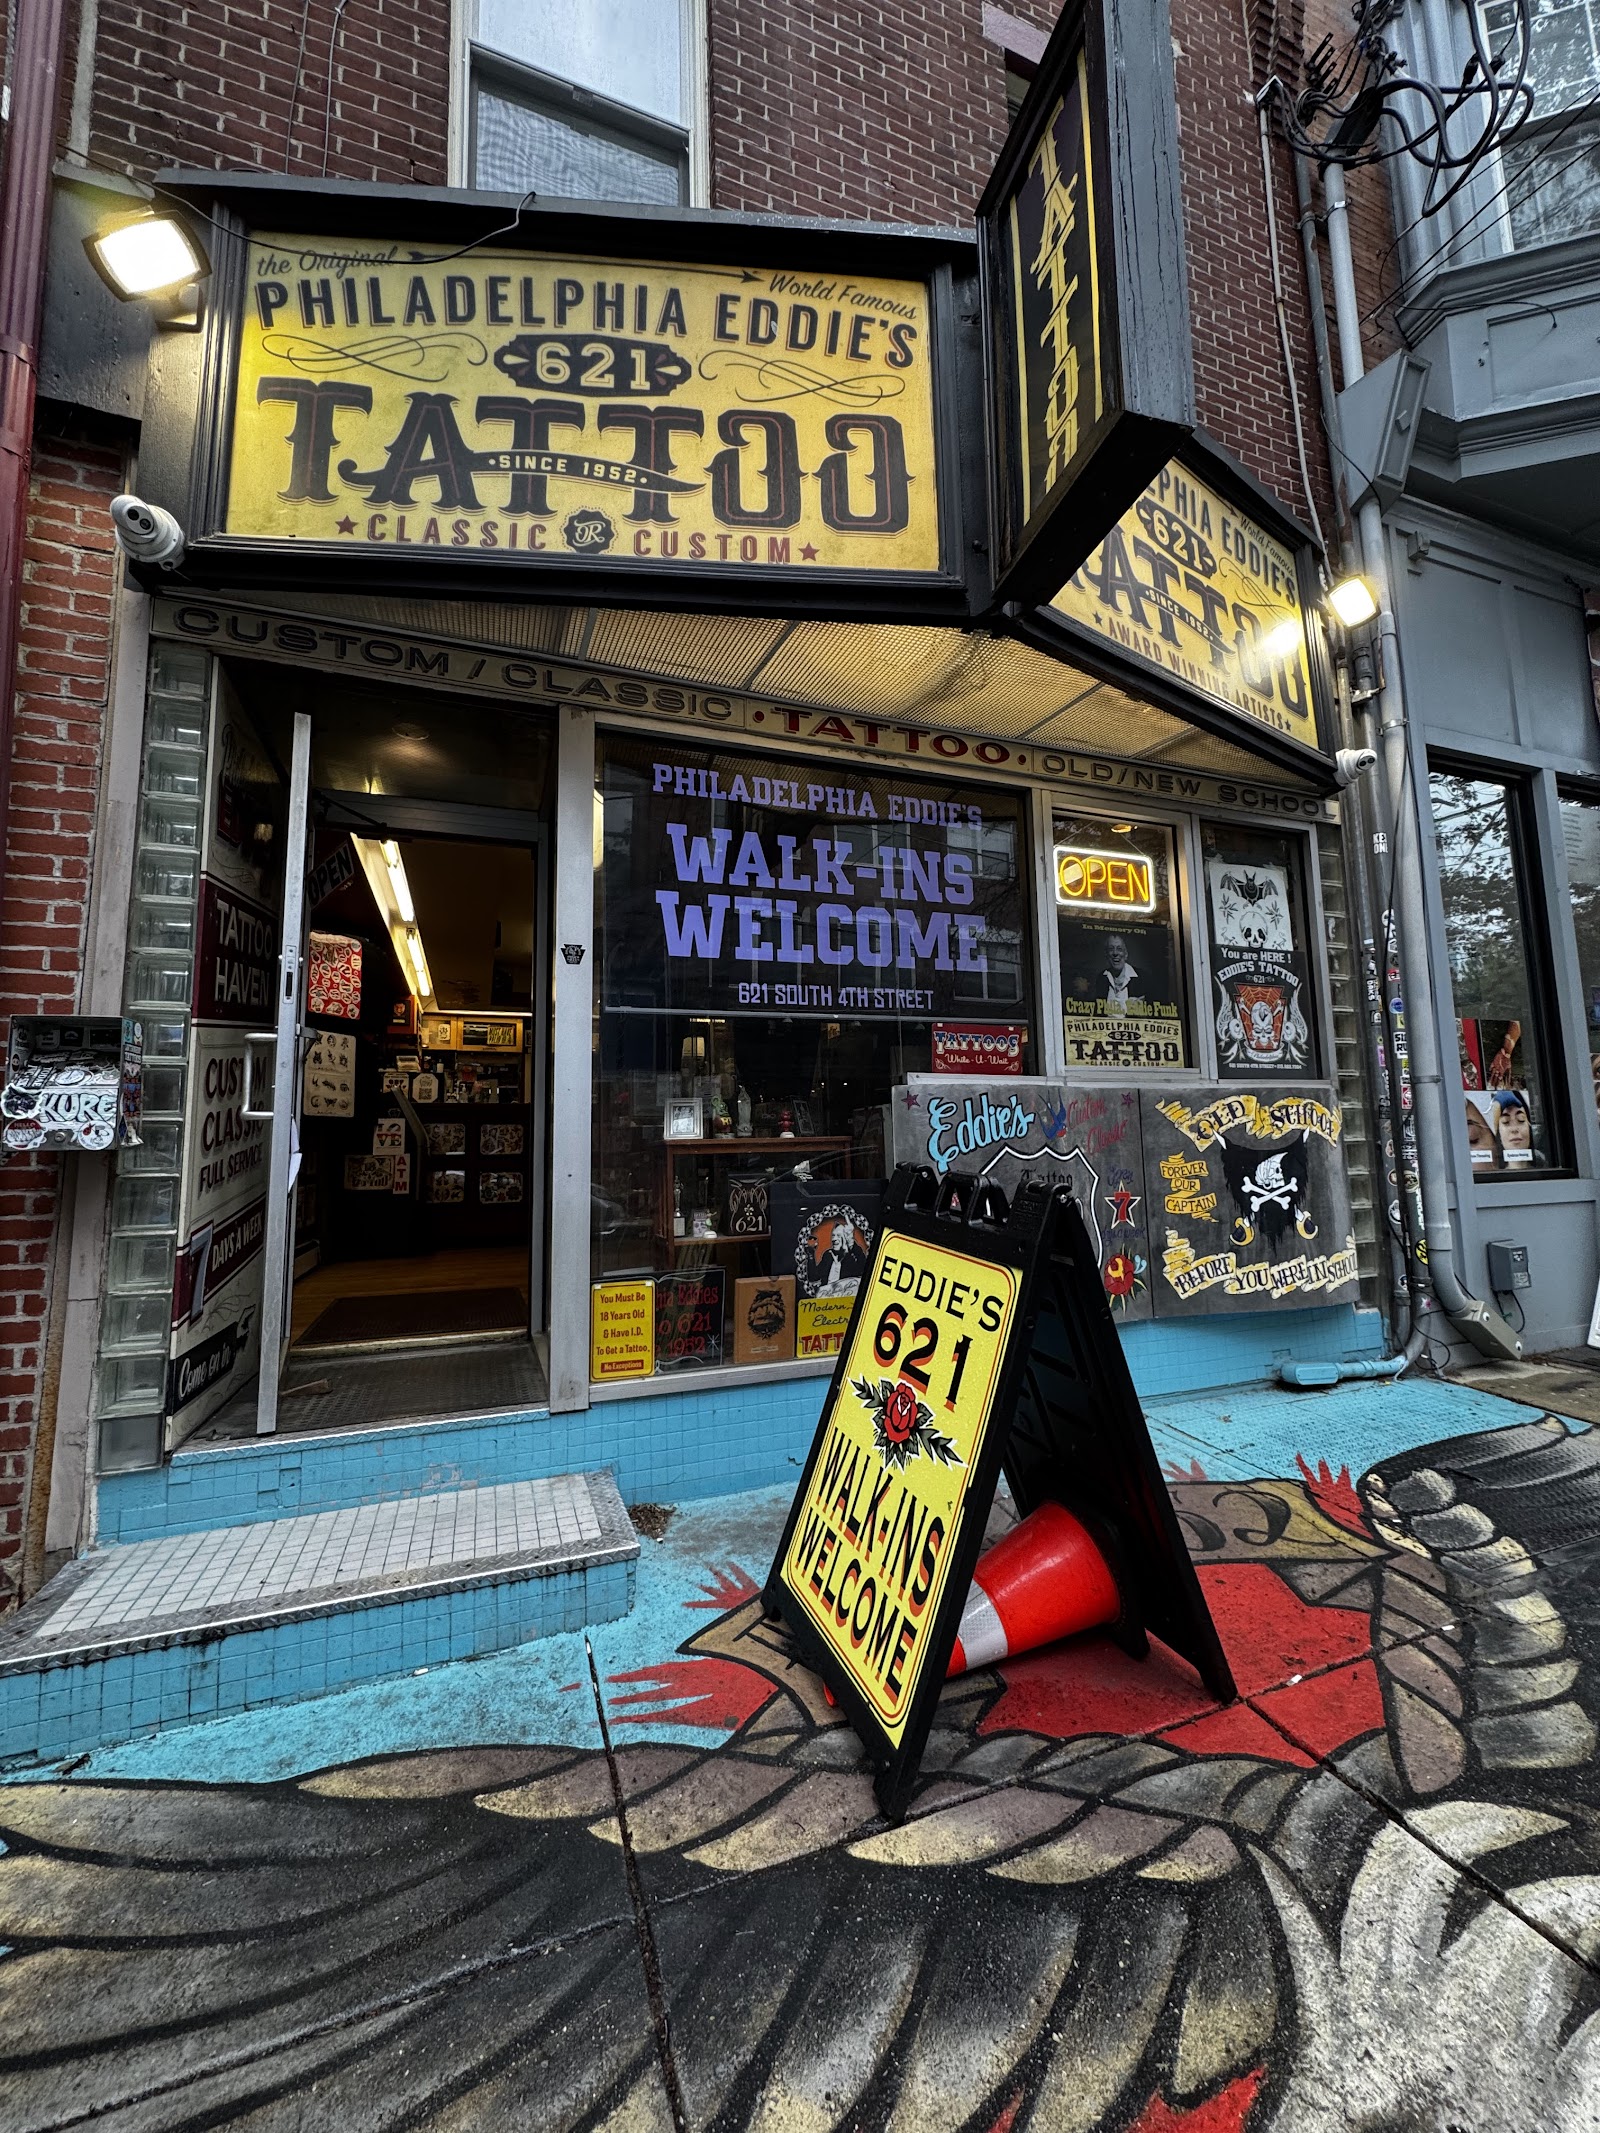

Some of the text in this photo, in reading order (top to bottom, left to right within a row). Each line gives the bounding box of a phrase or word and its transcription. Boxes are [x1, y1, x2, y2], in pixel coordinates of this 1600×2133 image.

[257, 246, 399, 279] the Original
[769, 273, 917, 320] World Famous
[254, 275, 918, 369] PHILADELPHIA EDDIE'S
[536, 342, 650, 390] 621
[256, 376, 917, 538] TATTOO
[498, 455, 637, 482] SINCE 1952
[368, 513, 546, 549] CLASSIC
[633, 529, 791, 564] CUSTOM
[1147, 468, 1296, 608] PHIA EDDIE'S
[1153, 510, 1203, 571] 621
[1241, 516, 1295, 578] World Famous
[1149, 590, 1209, 638] SINCE 1952
[173, 606, 449, 678] CUSTOM
[501, 664, 732, 719] CLASSIC
[1108, 617, 1284, 730] AWARD WINNING ARTISTS
[771, 707, 1010, 765] TATTOO
[1041, 754, 1200, 797] OLD/NEW
[652, 763, 982, 831] PHILADELPHIA EDDIE'S
[308, 845, 352, 906] OPEN
[666, 822, 974, 905] WALK-INS
[1060, 856, 1149, 902] OPEN
[216, 898, 274, 959] TATTOO
[655, 890, 988, 973] WELCOME
[1217, 961, 1300, 987] EDDIE'S TATTOO
[1221, 948, 1240, 959] You
[1242, 951, 1258, 961] are
[1260, 951, 1286, 963] HERE
[215, 956, 270, 1006] HAVEN
[738, 982, 934, 1011] 621 SOUTH 4TH STREET
[1253, 976, 1265, 984] 621
[1066, 996, 1095, 1016] Crazy
[1154, 1001, 1178, 1017] Funk
[934, 1031, 1020, 1057] TATTOOS
[1067, 1021, 1179, 1036] PHILADELPHIA EDDIE'S
[1114, 1032, 1136, 1040] 621
[1070, 1040, 1180, 1061] TATTOO
[206, 1057, 267, 1099] CUSTM
[41, 1093, 116, 1123] KURE
[1196, 1099, 1246, 1142] OLD
[1270, 1103, 1335, 1138] SCHOOL
[927, 1092, 1036, 1174] Eddie's
[200, 1143, 263, 1193] FULL SERVICE
[395, 1157, 407, 1192] ATM
[1161, 1162, 1206, 1178] FOREVER
[1174, 1178, 1197, 1190] OUR
[1114, 1192, 1131, 1222] 7
[1166, 1193, 1216, 1211] CAPTAIN
[736, 1215, 763, 1232] 621
[190, 1223, 213, 1323] 7
[211, 1238, 234, 1272] DAYS
[243, 1215, 263, 1244] WEEK
[1175, 1256, 1234, 1295] BEFORE
[1235, 1267, 1270, 1291] YOU
[1271, 1262, 1308, 1290] WERE
[1307, 1259, 1327, 1284] IN
[600, 1292, 645, 1303] You Must Be
[600, 1309, 645, 1321] 18 Years Old
[878, 1256, 1004, 1333] EDDIE'S
[603, 1326, 643, 1338] & Have I.D.
[677, 1312, 712, 1334] 621
[812, 1314, 849, 1327] Electr
[596, 1346, 604, 1355] To
[606, 1345, 617, 1354] Get
[625, 1344, 650, 1353] Tattoo.
[667, 1337, 707, 1357] 1952
[801, 1332, 845, 1354] TATT
[873, 1302, 973, 1414] 621
[179, 1358, 207, 1400] Come
[208, 1357, 220, 1378] on
[613, 1361, 642, 1370] Exceptions
[815, 1427, 946, 1617] WALK-INS
[795, 1506, 918, 1710] WELCOME
